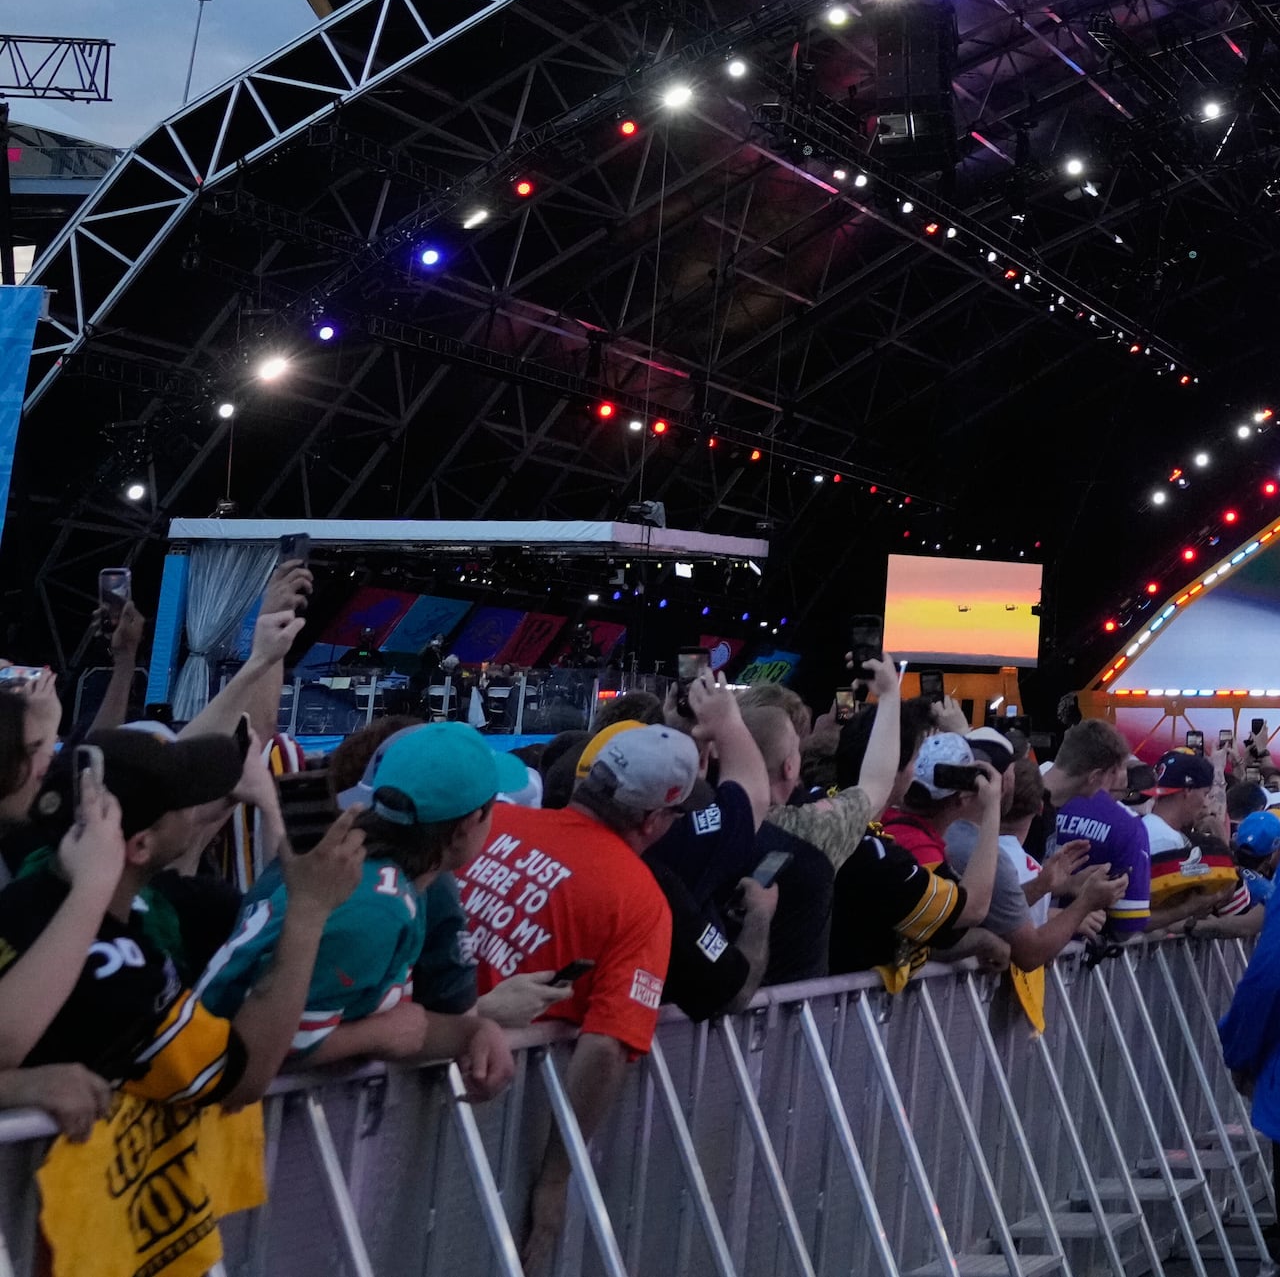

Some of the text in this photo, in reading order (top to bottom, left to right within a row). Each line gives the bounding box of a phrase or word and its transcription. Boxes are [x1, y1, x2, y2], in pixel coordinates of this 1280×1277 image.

[466, 855, 549, 913] HERE TO
[487, 833, 573, 890] IM JUST
[464, 887, 515, 929] WHO
[509, 918, 552, 954] MY
[471, 925, 523, 977] RUINS
